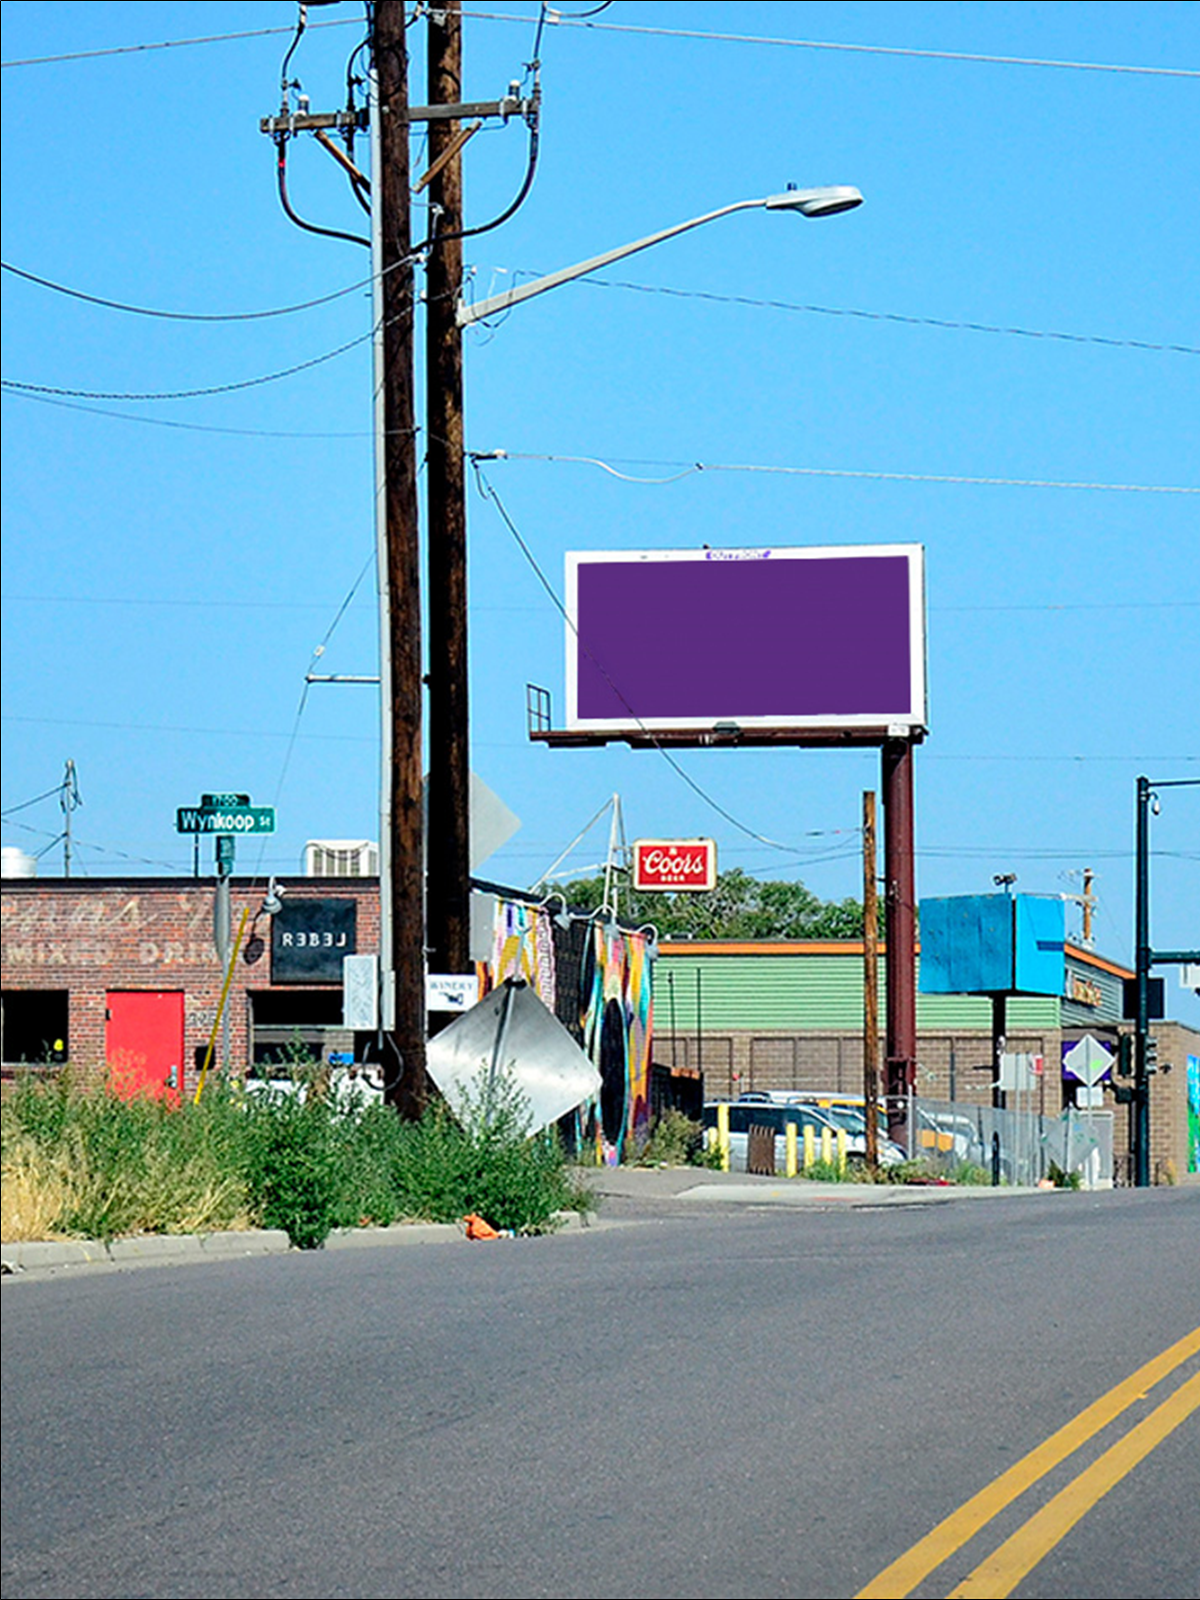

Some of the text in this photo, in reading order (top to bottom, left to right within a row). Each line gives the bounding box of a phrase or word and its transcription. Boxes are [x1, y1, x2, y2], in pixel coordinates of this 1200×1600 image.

[181, 811, 255, 833] Wynkoop
[642, 850, 703, 874] Coors
[430, 982, 473, 990] WINERY
